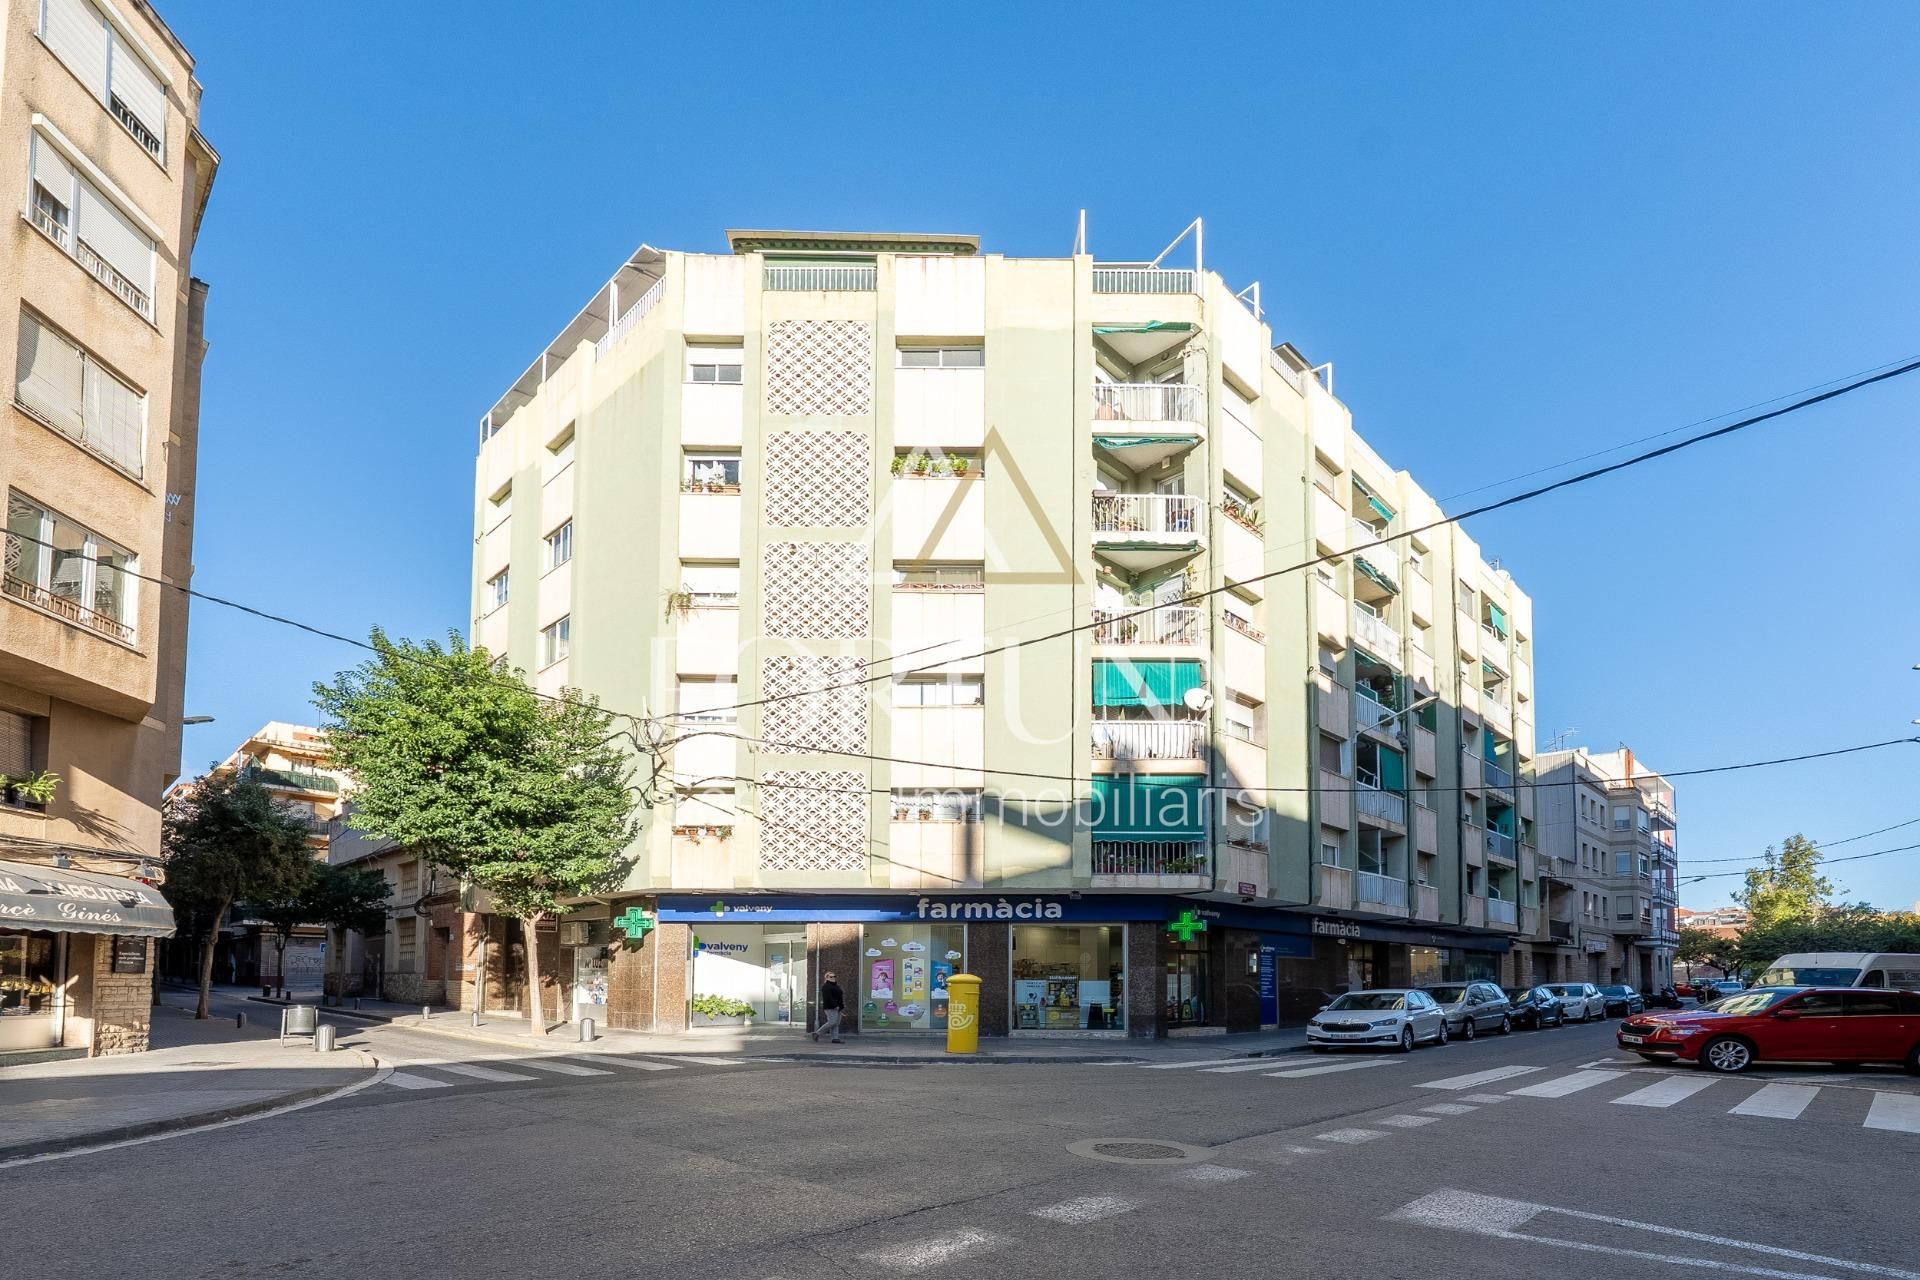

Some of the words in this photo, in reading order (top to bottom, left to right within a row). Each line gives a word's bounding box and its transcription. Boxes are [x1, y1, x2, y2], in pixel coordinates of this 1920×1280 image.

[58, 902, 122, 922] Ginés
[733, 904, 773, 913] valveny
[917, 898, 1062, 918] farmàcia
[706, 942, 749, 952] valveny
